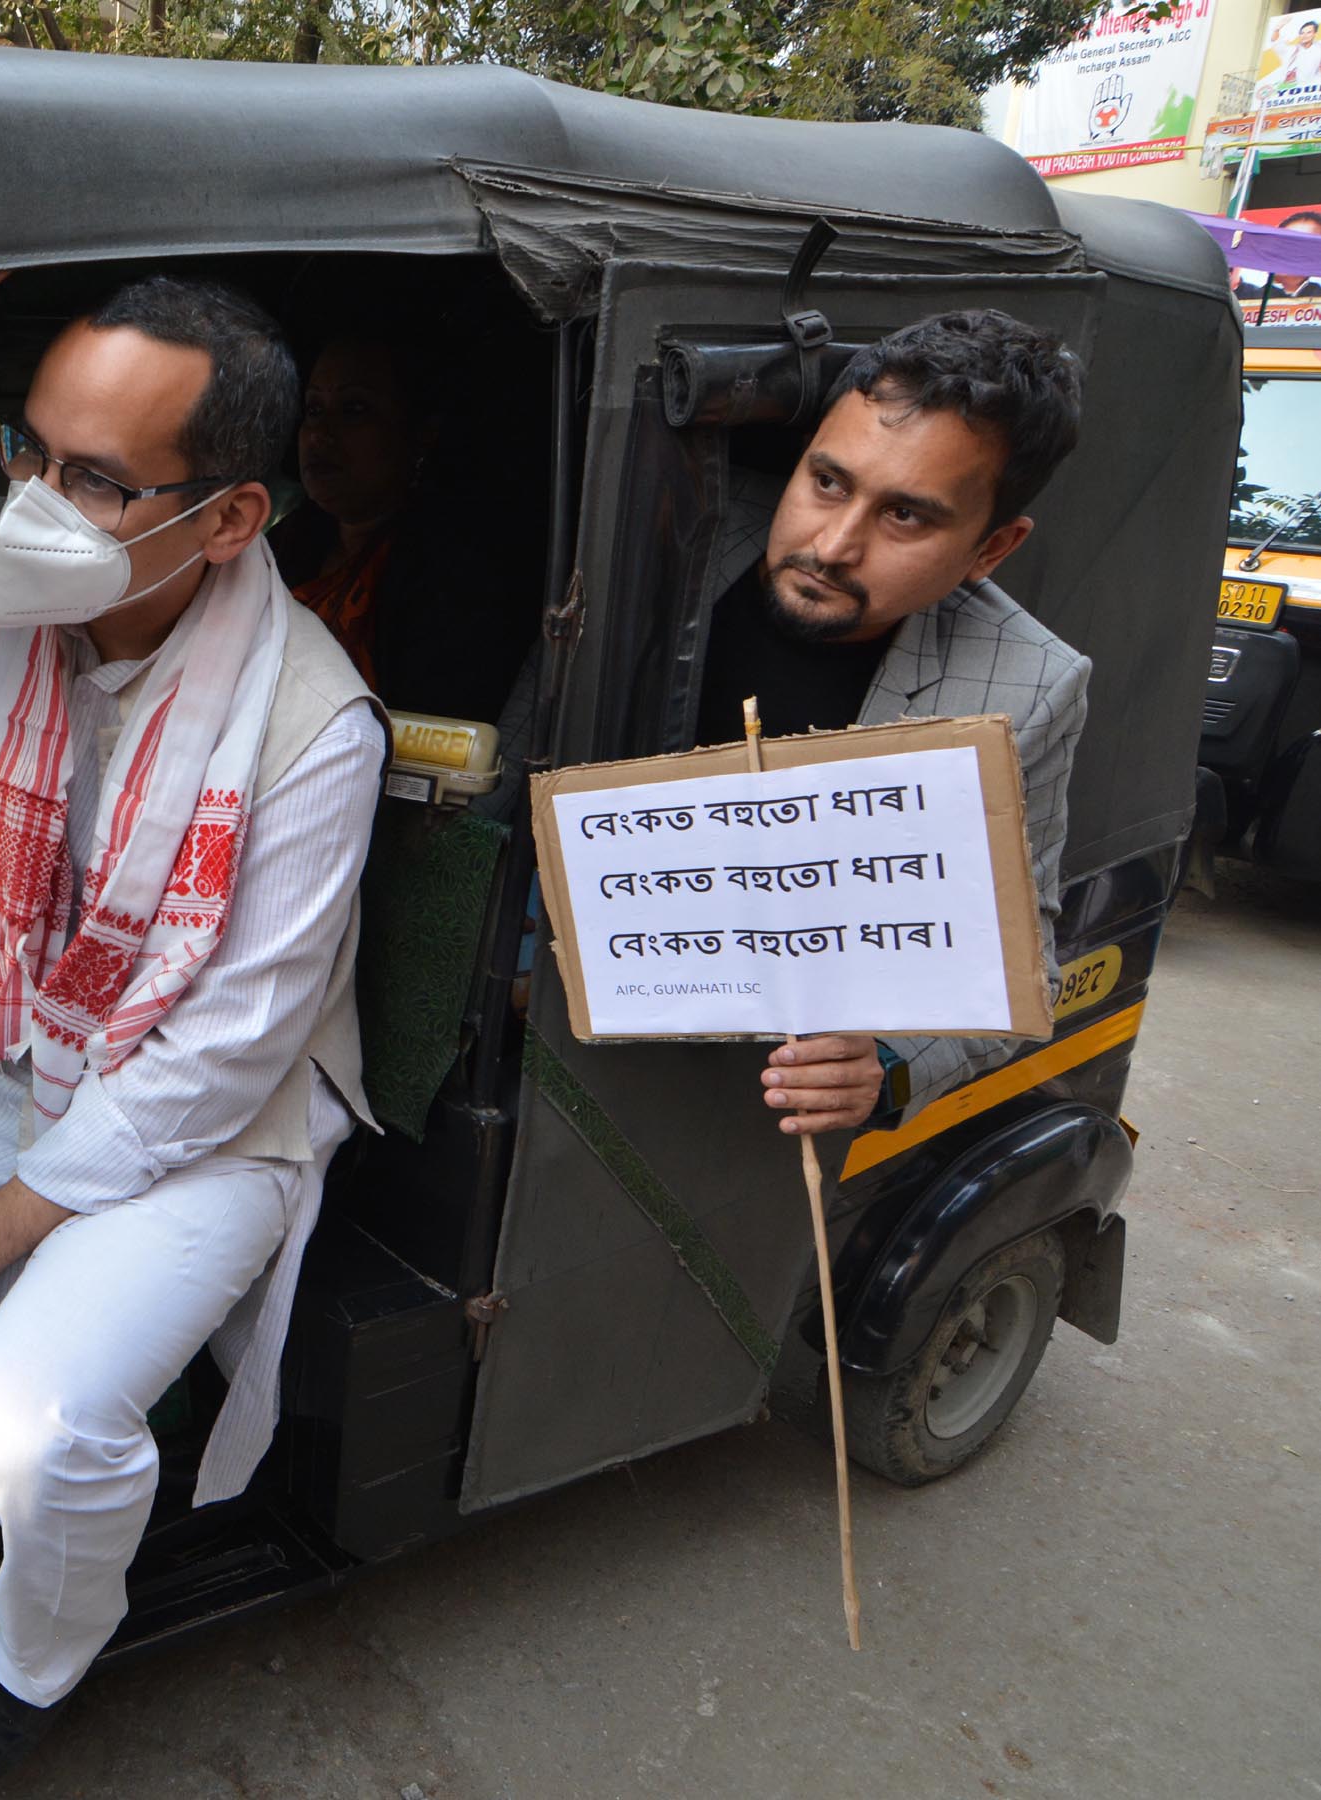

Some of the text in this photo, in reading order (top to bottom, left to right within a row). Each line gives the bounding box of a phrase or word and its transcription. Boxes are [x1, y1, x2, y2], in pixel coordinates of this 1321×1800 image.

[1081, 44, 1116, 59] General
[1119, 37, 1165, 53] Secretary,
[1167, 29, 1192, 44] AICC
[1078, 54, 1151, 75] Incharge Assam
[1277, 84, 1321, 97] YOU
[1262, 97, 1295, 108] SSAM
[1053, 156, 1095, 173] PRADESH
[1097, 148, 1129, 168] YOUTH
[1222, 582, 1268, 604] S01L
[1218, 600, 1266, 620] 0230
[402, 725, 468, 753] HIRE
[581, 805, 696, 840] বেংকত
[600, 867, 716, 900] বেংকত
[609, 930, 725, 959] বেংকত
[615, 982, 762, 997] AIPC, GUWAHATI LSC
